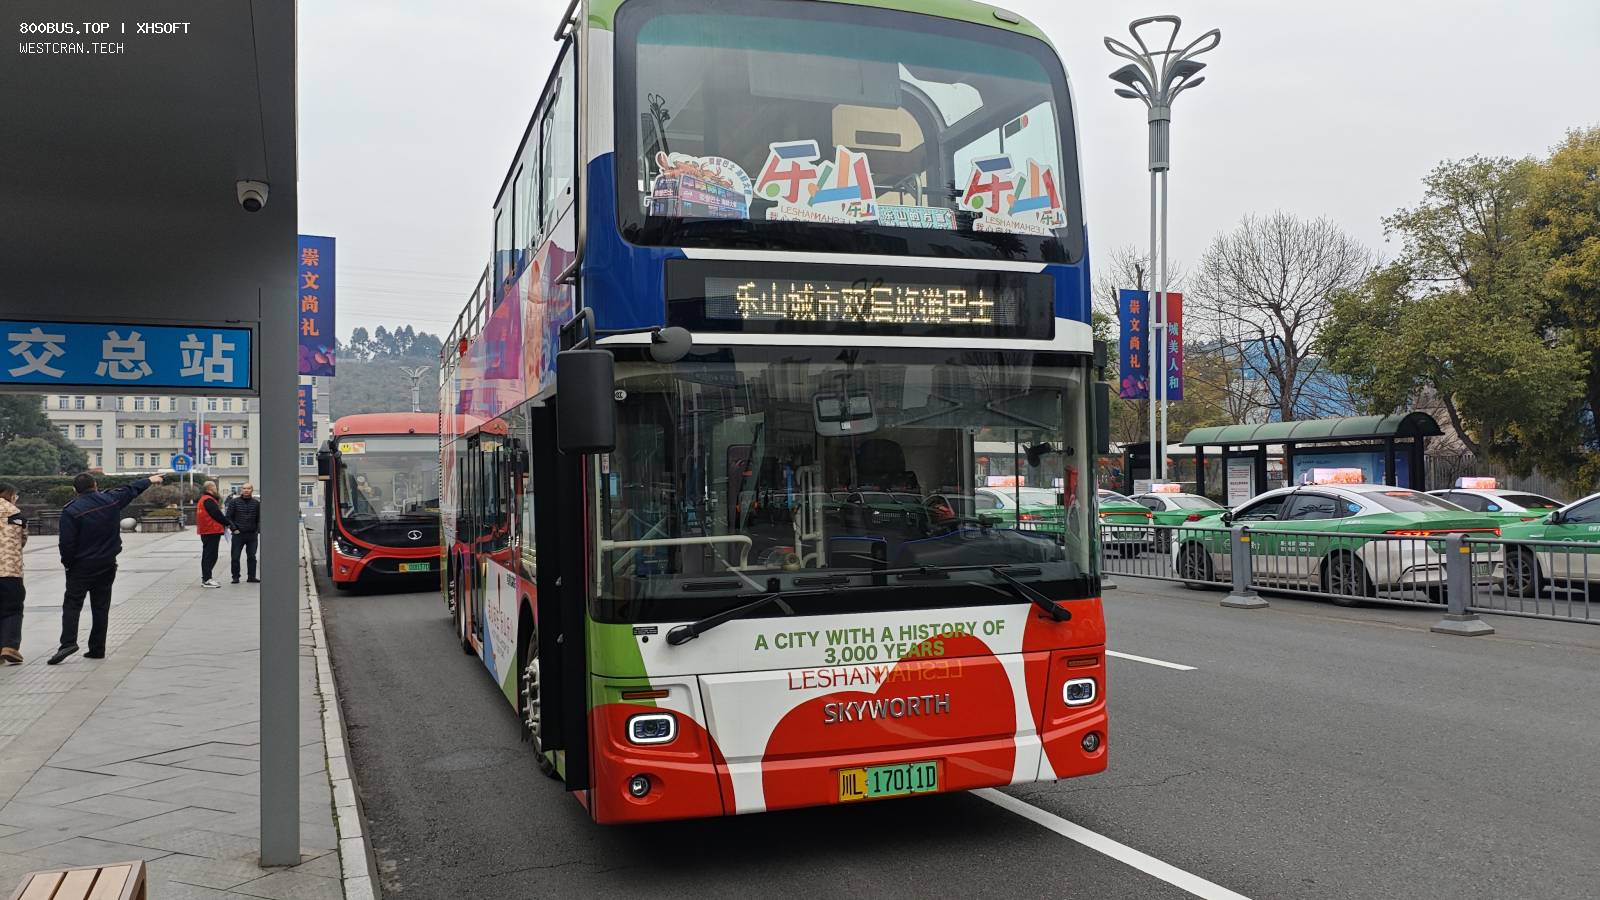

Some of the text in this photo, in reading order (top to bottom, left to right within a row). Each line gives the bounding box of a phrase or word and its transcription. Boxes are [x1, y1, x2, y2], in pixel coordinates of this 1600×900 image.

[758, 143, 872, 204] 乐山
[963, 156, 1061, 214] 乐山
[301, 248, 320, 337] 崇文尚礼
[8, 327, 236, 383] 交总站
[754, 620, 1005, 650] A CITY WITH A HISTORY OF
[824, 640, 945, 664] 3,000 YEARS
[788, 665, 880, 690] LESHAN
[824, 693, 950, 724] SKYWORTH
[842, 773, 863, 796] 川L
